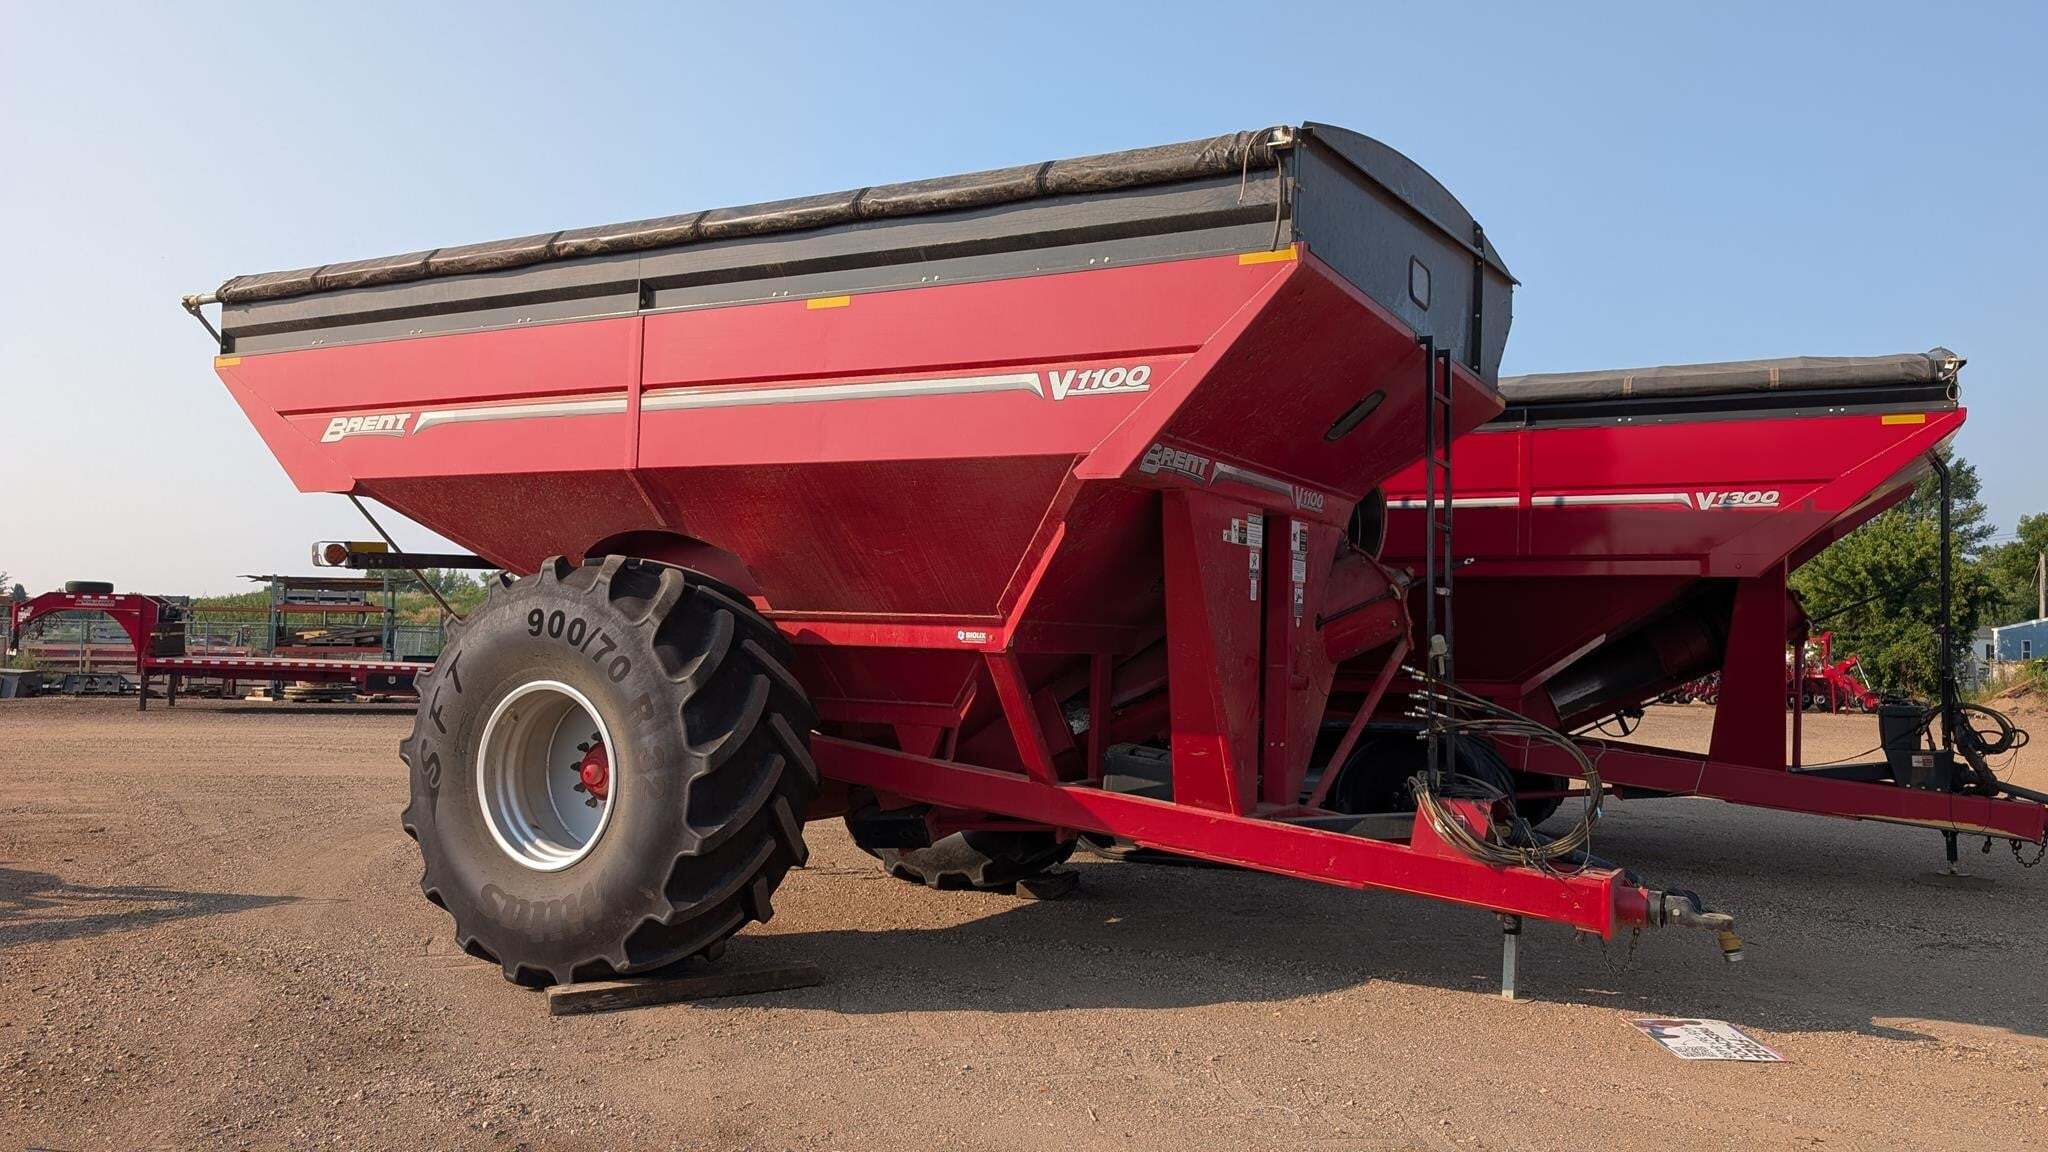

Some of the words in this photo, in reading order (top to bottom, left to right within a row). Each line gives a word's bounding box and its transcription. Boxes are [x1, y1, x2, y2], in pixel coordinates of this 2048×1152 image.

[1048, 365, 1152, 400] V1100
[320, 413, 412, 443] BRENT
[1139, 442, 1210, 480] BRENT
[1295, 485, 1324, 511] V1100
[1695, 490, 1780, 511] V1300
[527, 607, 632, 685] 900/70
